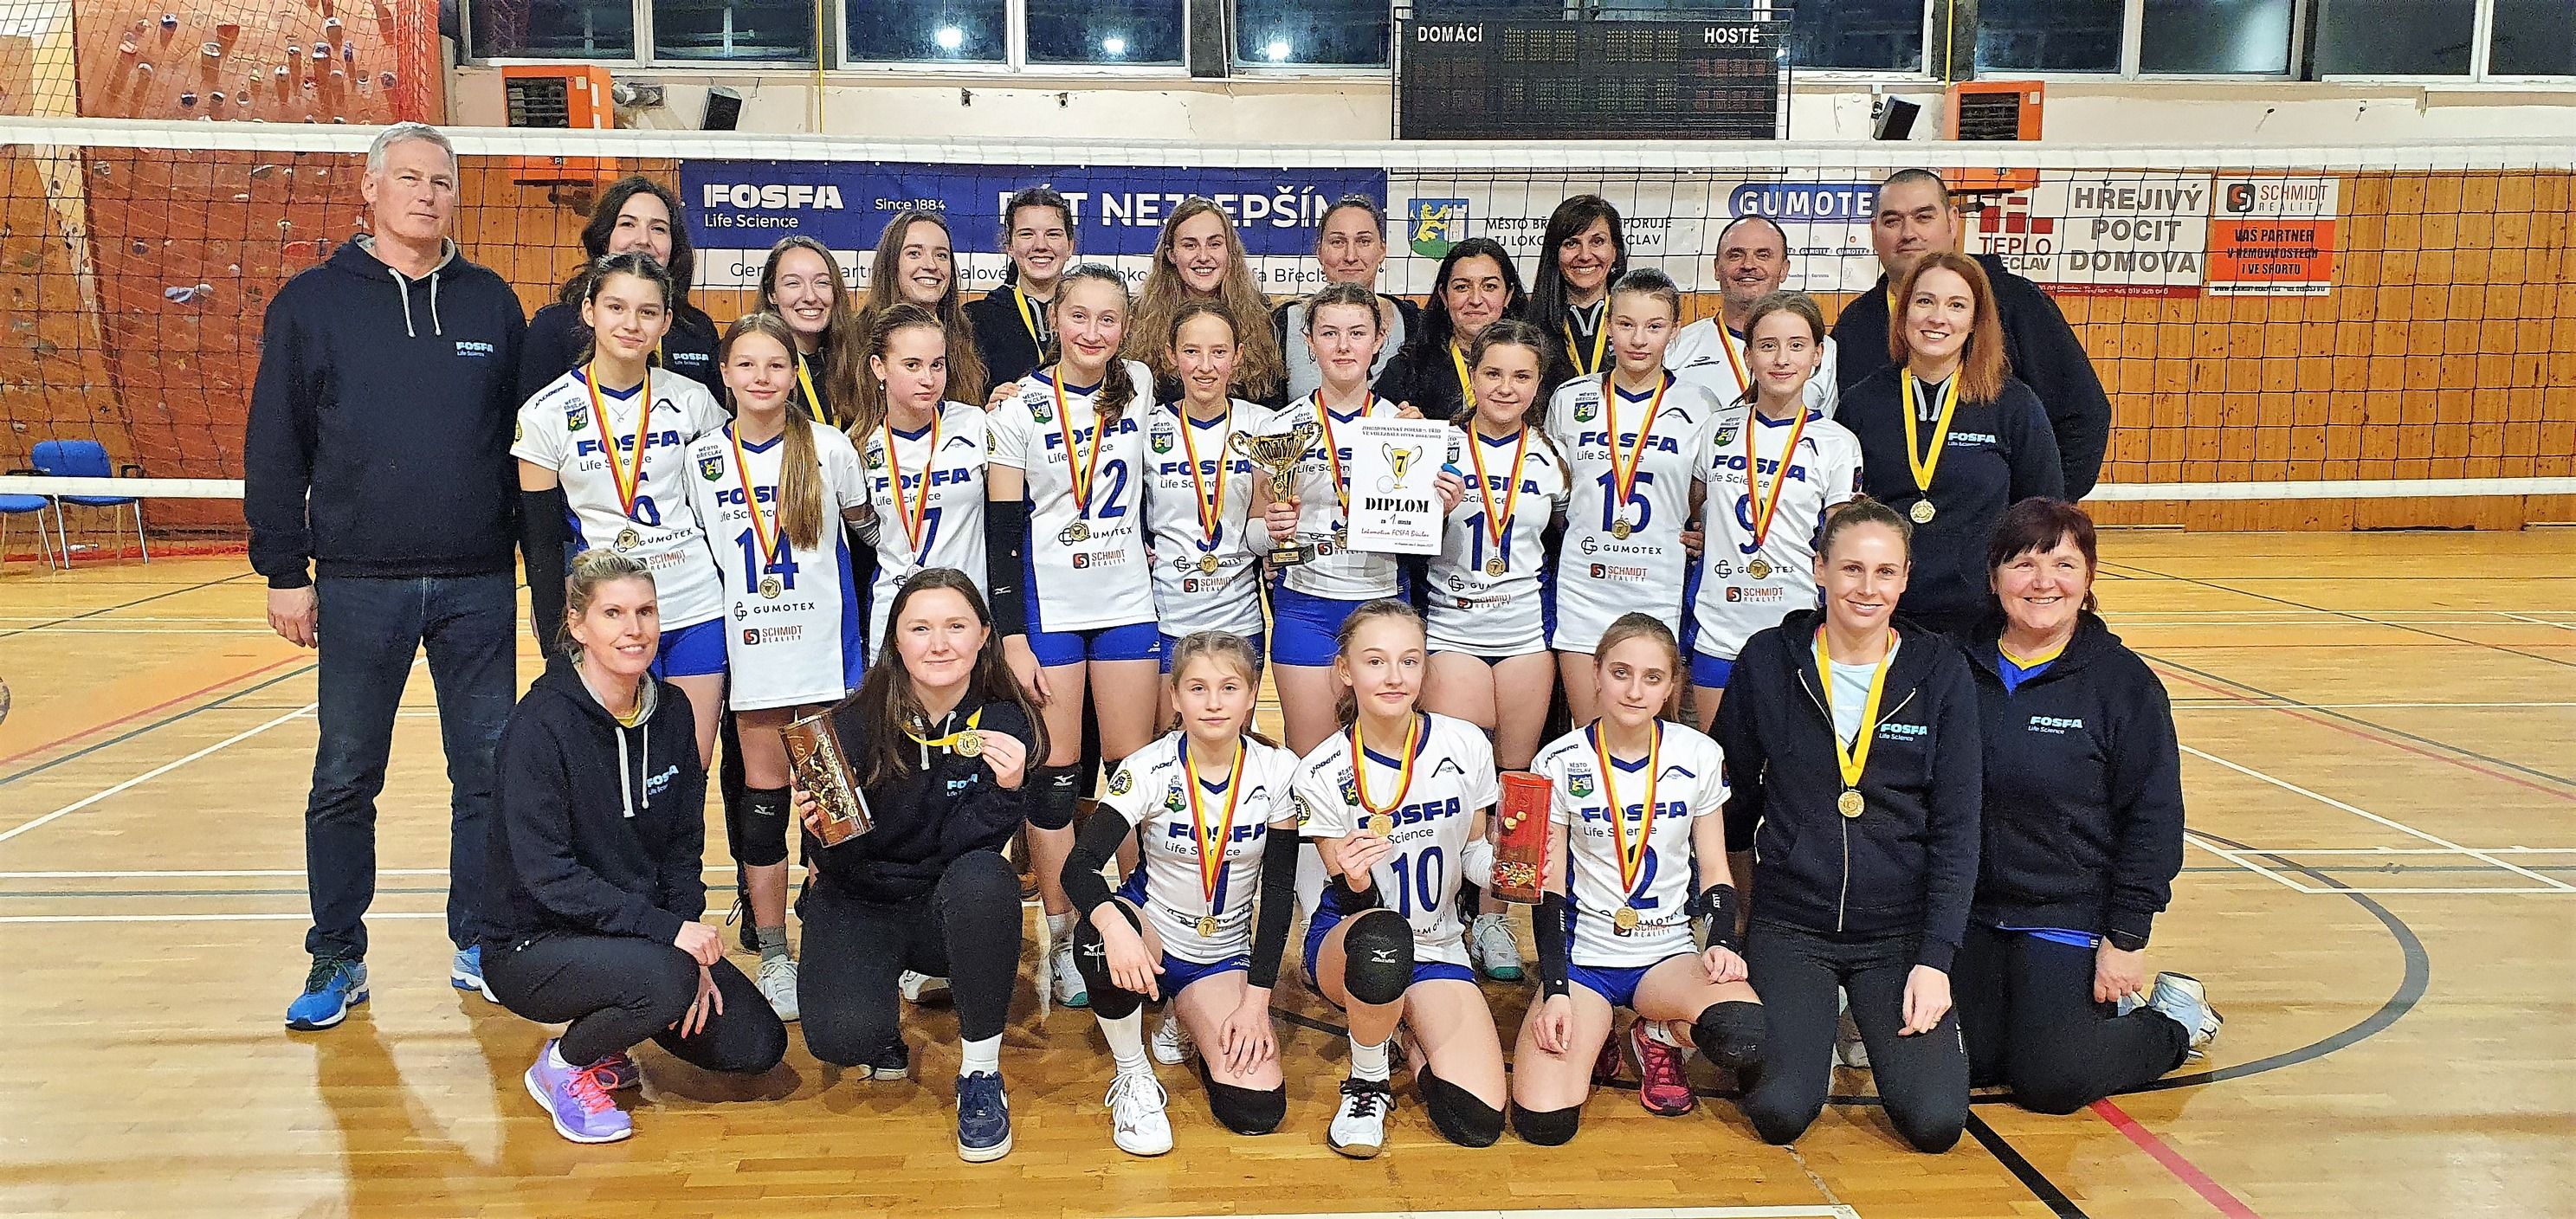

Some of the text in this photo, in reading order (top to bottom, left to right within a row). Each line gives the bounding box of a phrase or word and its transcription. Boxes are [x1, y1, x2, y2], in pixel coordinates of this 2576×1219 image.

[1417, 23, 1483, 42] DOMÁCÍ
[1704, 26, 1759, 44] HOSTÉ
[703, 184, 844, 210] FOSFA
[2260, 184, 2329, 201] SCHMIDT
[875, 198, 946, 211] Since 1884
[1739, 190, 1875, 216] GUMOTE
[2258, 202, 2324, 211] REALITY
[705, 214, 799, 229] Life Science
[1486, 217, 1528, 229] MĚSTO
[2090, 219, 2182, 242] POCIT
[2260, 229, 2315, 242] PARTNER
[1495, 235, 1507, 246] TJ
[1979, 237, 2051, 255] TEPLO
[2069, 250, 2197, 273] DOMOVA
[2248, 263, 2260, 274] VE
[2262, 263, 2302, 274] SPORTU
[455, 341, 494, 353] FOSFA
[672, 352, 709, 361] FOSFA
[1578, 431, 1679, 455] FOSFA
[1948, 432, 1997, 444] FOSFA
[1048, 452, 1068, 464] Life
[1300, 447, 1353, 461] FOS
[1577, 450, 1595, 461] Life
[579, 456, 602, 472] Life
[1297, 464, 1315, 474] Life
[1396, 455, 1406, 473] 7
[1160, 479, 1178, 489] Life
[1463, 474, 1541, 495] OSFA
[1725, 474, 1770, 488] Sciece
[1079, 458, 1128, 520] 12
[715, 486, 778, 508] FOS
[875, 493, 892, 506] Life
[1462, 493, 1507, 505] Sciece
[1596, 468, 1655, 534] 15
[1365, 497, 1430, 513] DIPLOM
[910, 507, 943, 567] 7
[1088, 526, 1133, 540] UMTEX
[1091, 549, 1126, 561] SCHMIDT
[1603, 544, 1662, 556] GUMOTEX
[649, 551, 687, 564] SCHMIDT
[734, 526, 799, 595] 14
[1608, 564, 1648, 576] SCHMIDT
[1737, 565, 1796, 574] GUOTEX
[1743, 587, 1784, 597] SCHMIDT
[753, 602, 816, 615] GUMOTEX
[762, 625, 804, 637] SCHMIDT
[2029, 715, 2083, 729] FOSFA
[1880, 723, 1927, 736] FOSFA
[647, 764, 680, 788] FOSA
[946, 773, 978, 790] FOA
[1580, 801, 1688, 822] FOSFA
[1386, 828, 1434, 845] Science
[1583, 826, 1604, 837] Life
[1165, 840, 1187, 855] Life
[1390, 846, 1444, 919] 10
[1627, 843, 1659, 909] 2
